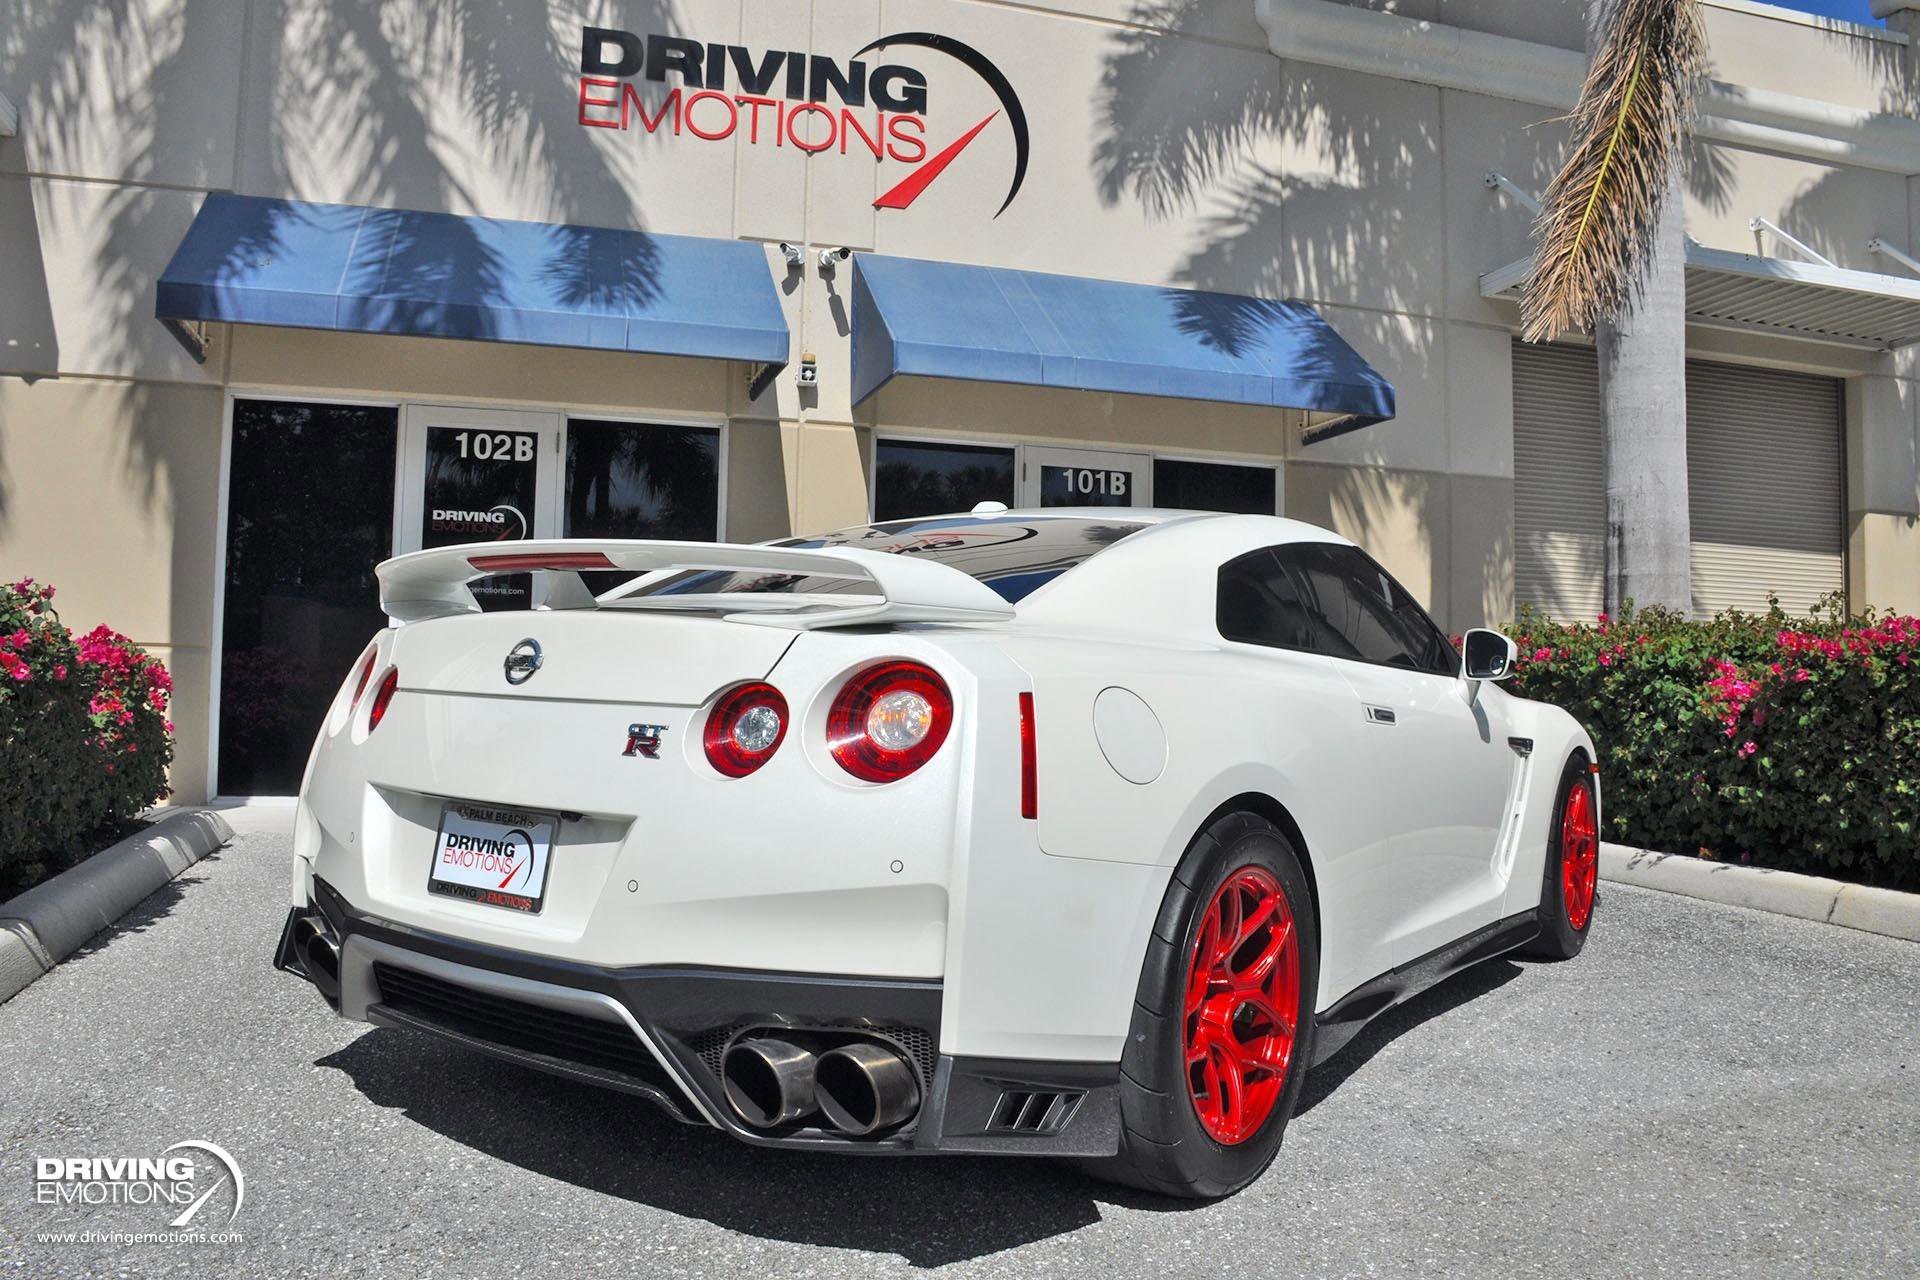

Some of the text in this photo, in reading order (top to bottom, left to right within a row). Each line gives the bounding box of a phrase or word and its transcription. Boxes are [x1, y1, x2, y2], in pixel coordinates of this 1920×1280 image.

[580, 26, 928, 116] DRIVING
[578, 77, 927, 163] EMOTIONS
[455, 432, 534, 462] 102B
[1062, 468, 1126, 496] 101B
[431, 520, 504, 533] EMOTIONS
[432, 509, 505, 524] DRIVING
[469, 807, 528, 826] PALM BEACH
[446, 833, 516, 858] DRIVING
[443, 847, 514, 875] EMOTIONS
[436, 882, 533, 909] DRIVING EMOTIONS
